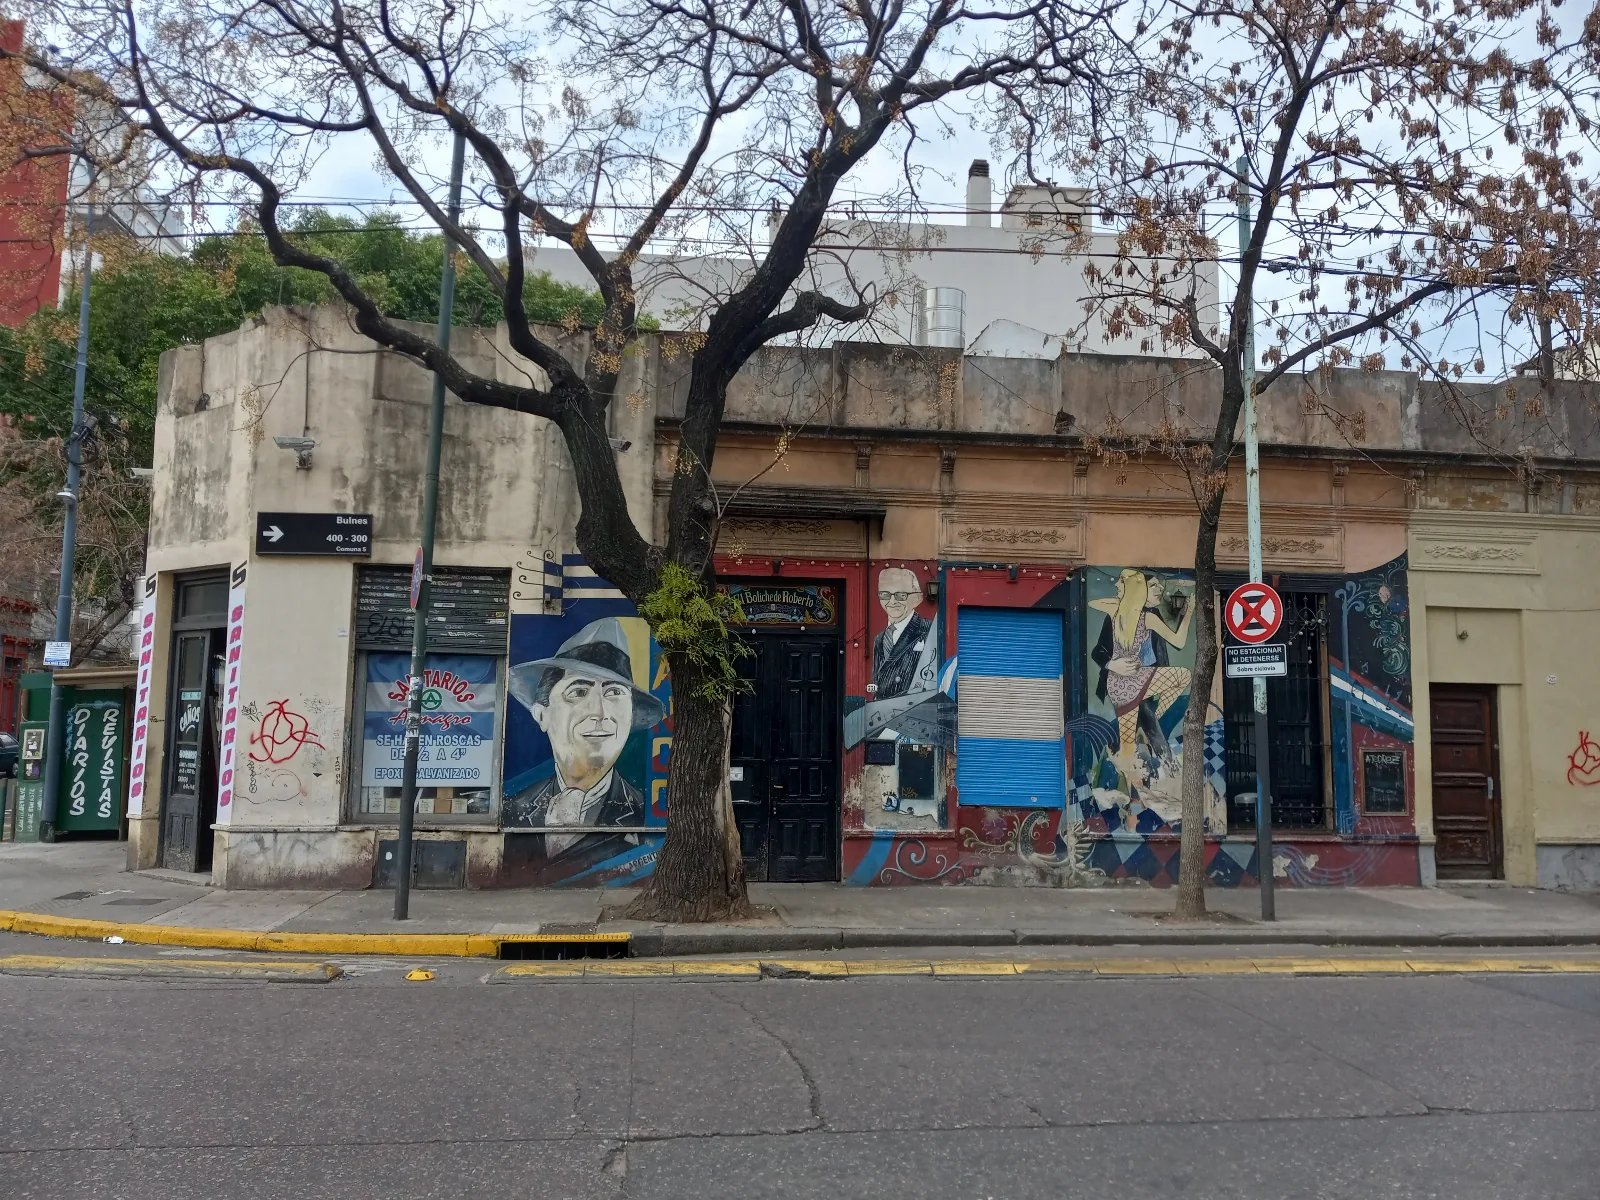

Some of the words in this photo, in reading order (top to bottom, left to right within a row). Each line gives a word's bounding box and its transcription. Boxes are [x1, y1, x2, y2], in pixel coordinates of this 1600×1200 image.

[336, 516, 368, 525] Bulnes
[326, 534, 343, 543] 400
[350, 534, 368, 543] 300
[745, 590, 774, 604] Boliche
[774, 590, 782, 602] de
[782, 590, 814, 608] Roberto
[1239, 647, 1283, 655] ESTACIONAR
[1240, 655, 1280, 663] DETENERSE
[388, 669, 475, 703] SATARIOS
[130, 612, 154, 798] SANITARIOS
[219, 604, 244, 807] SANITARIOS
[179, 703, 201, 732] CAÑOS
[389, 708, 472, 731] Amagro
[376, 734, 391, 746] SE
[393, 734, 433, 746] HAEN
[436, 734, 482, 746] ROSCAS
[69, 708, 91, 816] DIARIOS
[97, 708, 120, 818] REVISTAS
[436, 747, 446, 760] A
